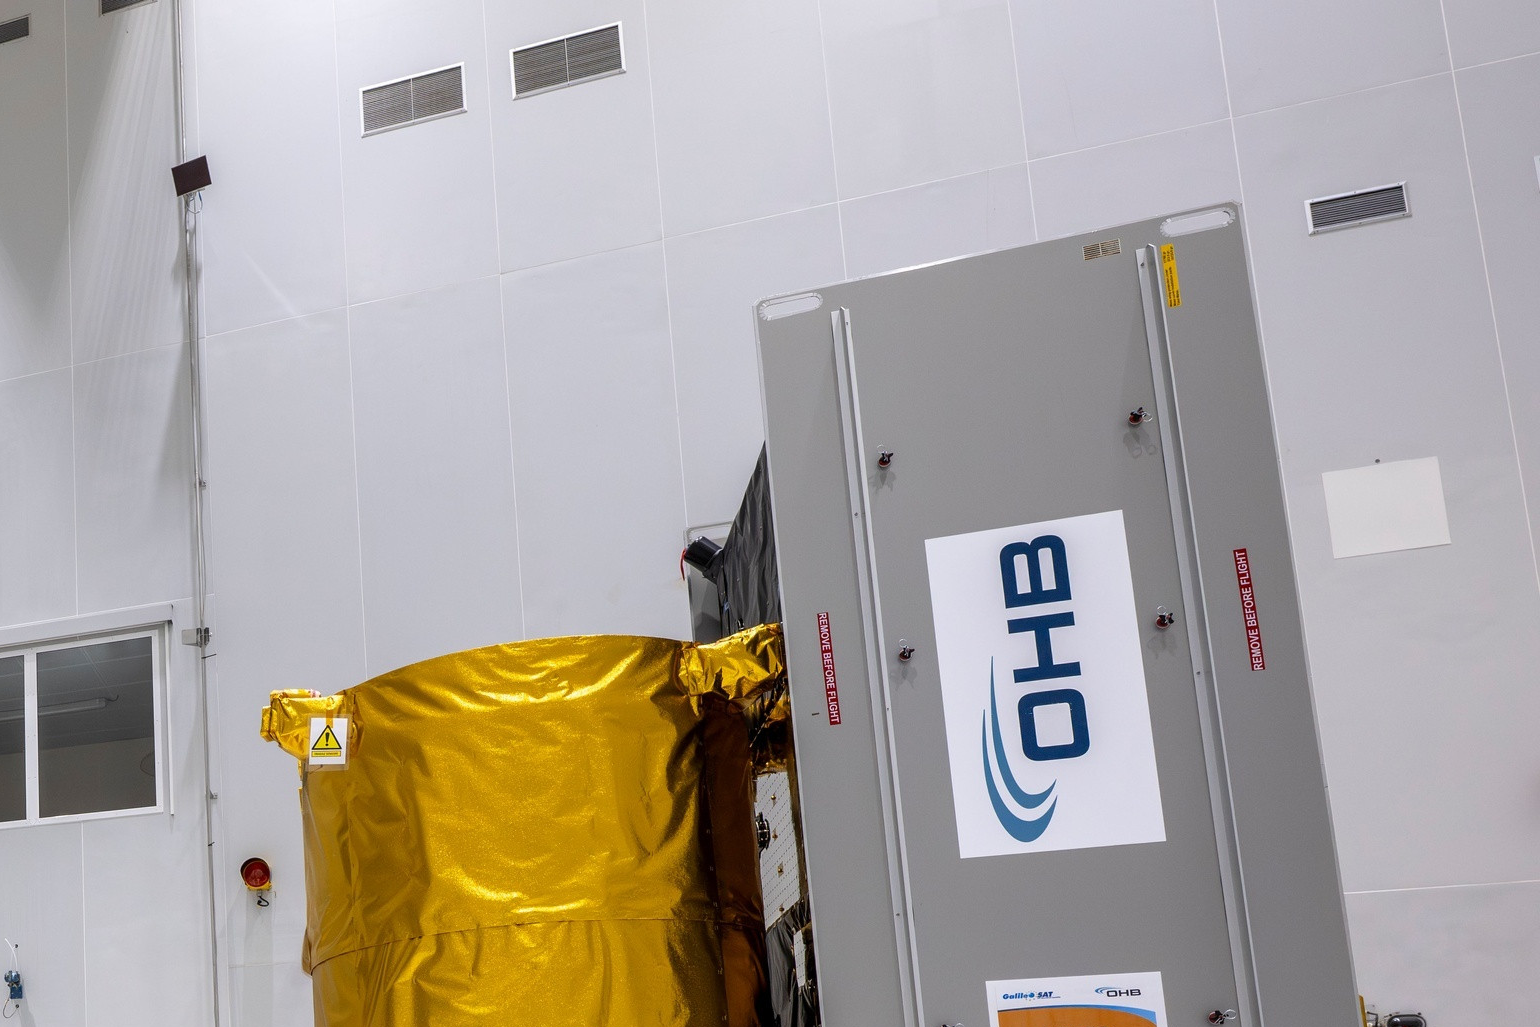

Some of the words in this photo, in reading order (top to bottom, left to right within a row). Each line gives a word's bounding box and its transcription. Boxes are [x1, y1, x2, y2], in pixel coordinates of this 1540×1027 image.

[1235, 552, 1250, 585] FLIGHT
[1241, 587, 1257, 627] BEFORE
[819, 613, 831, 650] REMOVE
[999, 534, 1091, 762] OHB
[1248, 628, 1263, 670] REMOVE
[823, 652, 835, 689] BEFORE
[828, 691, 840, 722] FLIGHT
[1037, 991, 1054, 999] SAT
[1106, 988, 1142, 998] OHB
